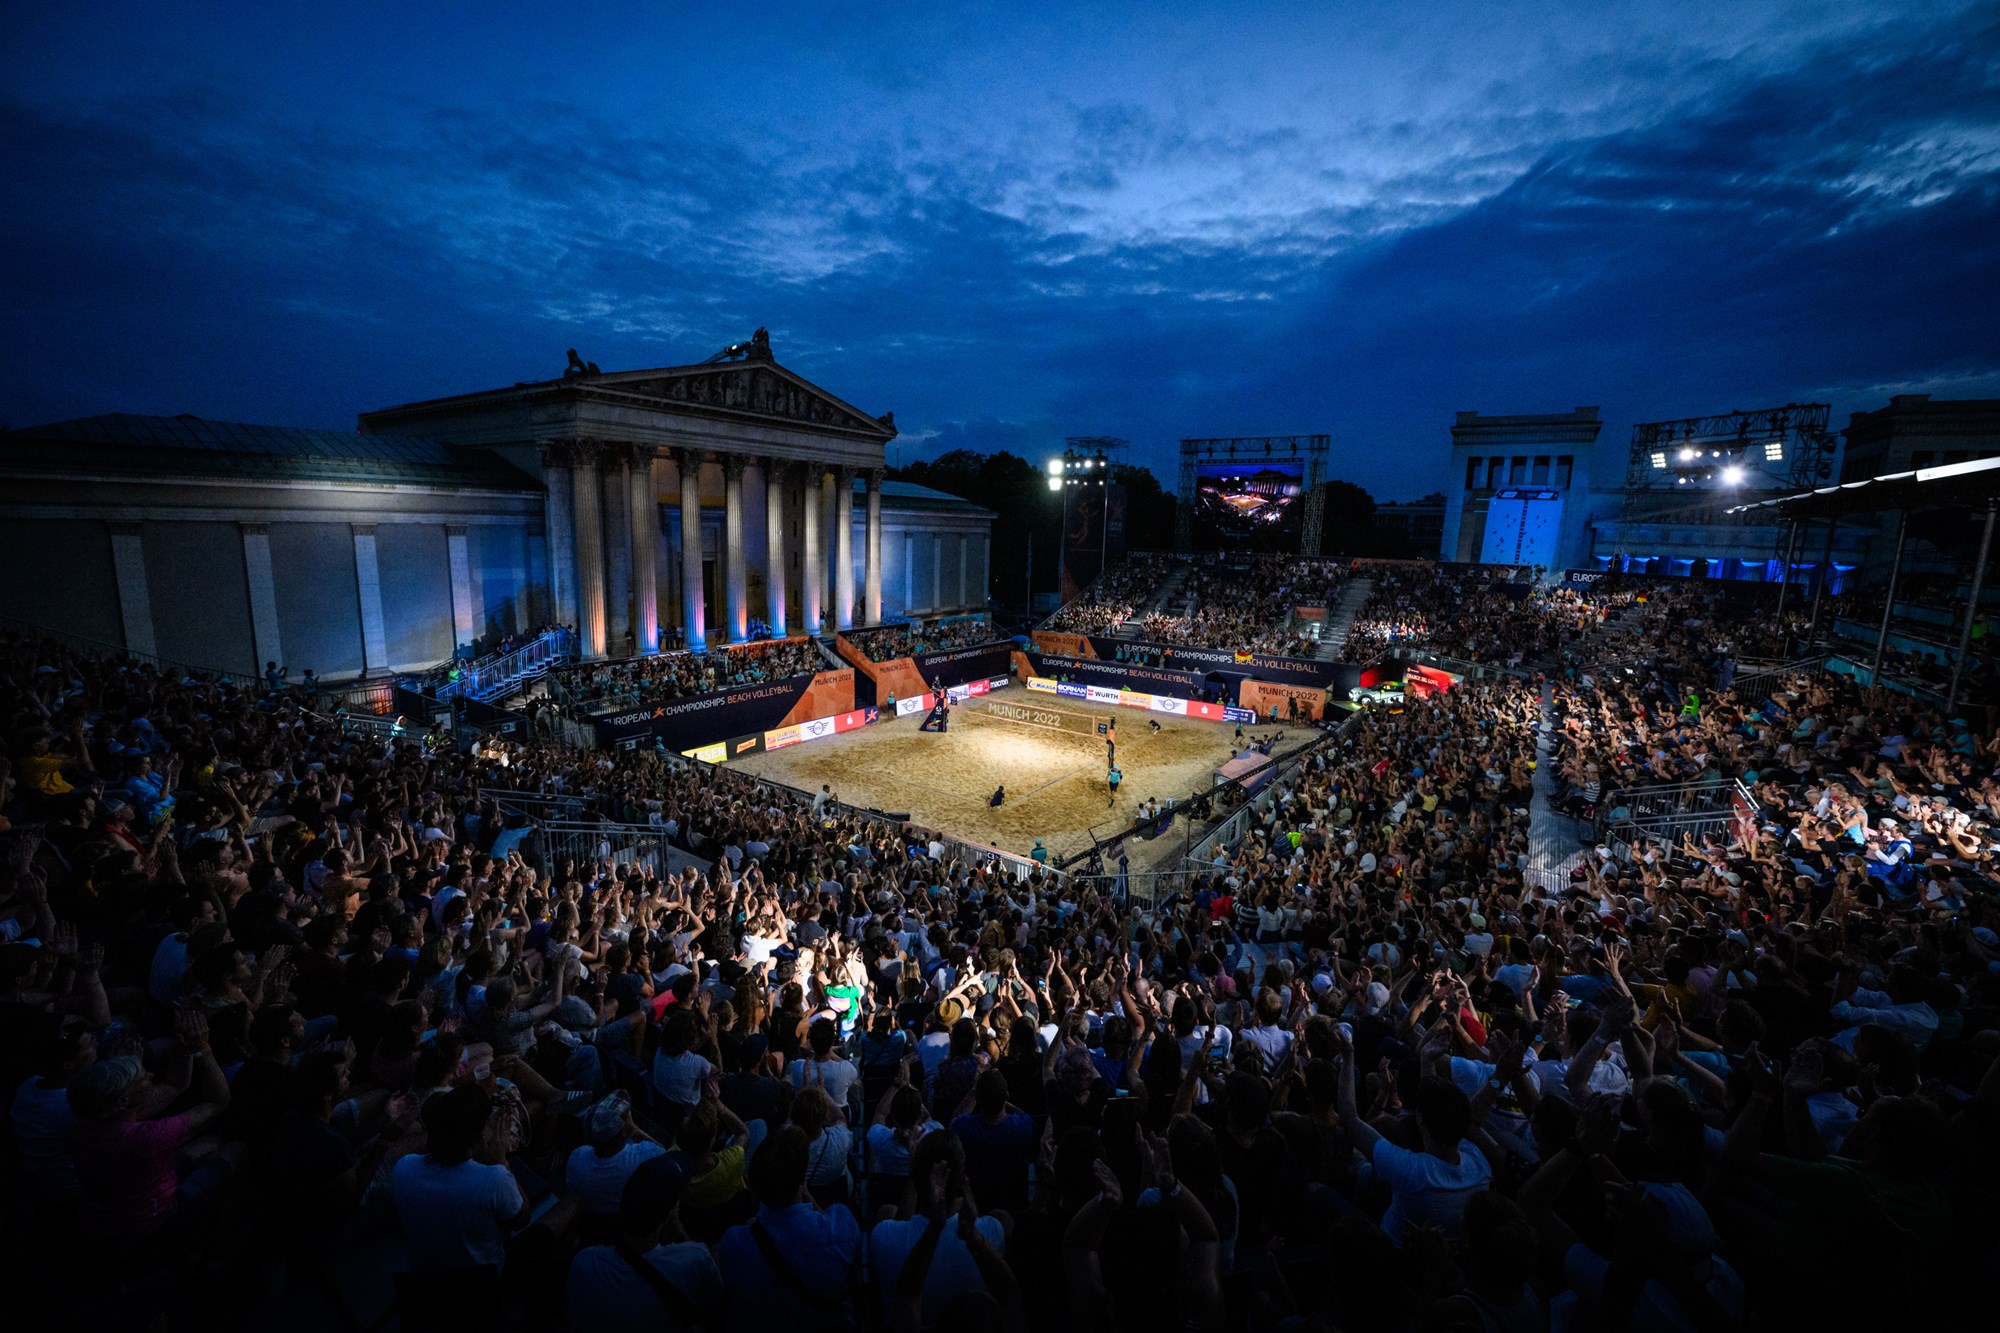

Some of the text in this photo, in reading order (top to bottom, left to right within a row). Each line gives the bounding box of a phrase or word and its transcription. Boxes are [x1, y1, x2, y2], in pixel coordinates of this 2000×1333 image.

[925, 656, 948, 666] EUROPEAN
[1174, 651, 1232, 664] CHAMPIONSHIPS
[1264, 660, 1319, 674] VOLLEYBALL
[1042, 658, 1193, 684] EUROPEAN CHAMPIONSHIPS BEACH VOLLEYBALL
[815, 673, 852, 686] MUNICH 2022
[990, 678, 1009, 689] macron
[1057, 684, 1087, 694] BORNAN
[1258, 685, 1319, 701] MUNICH 2022
[666, 697, 725, 716] CHAMPIONSHIPS
[727, 693, 751, 705] BEACH
[752, 684, 794, 700] VOLLEYBALL
[988, 702, 1061, 727] MUNICH 2022
[695, 746, 726, 762] SSER
[1638, 805, 1652, 815] B4
[987, 852, 995, 860] C3
